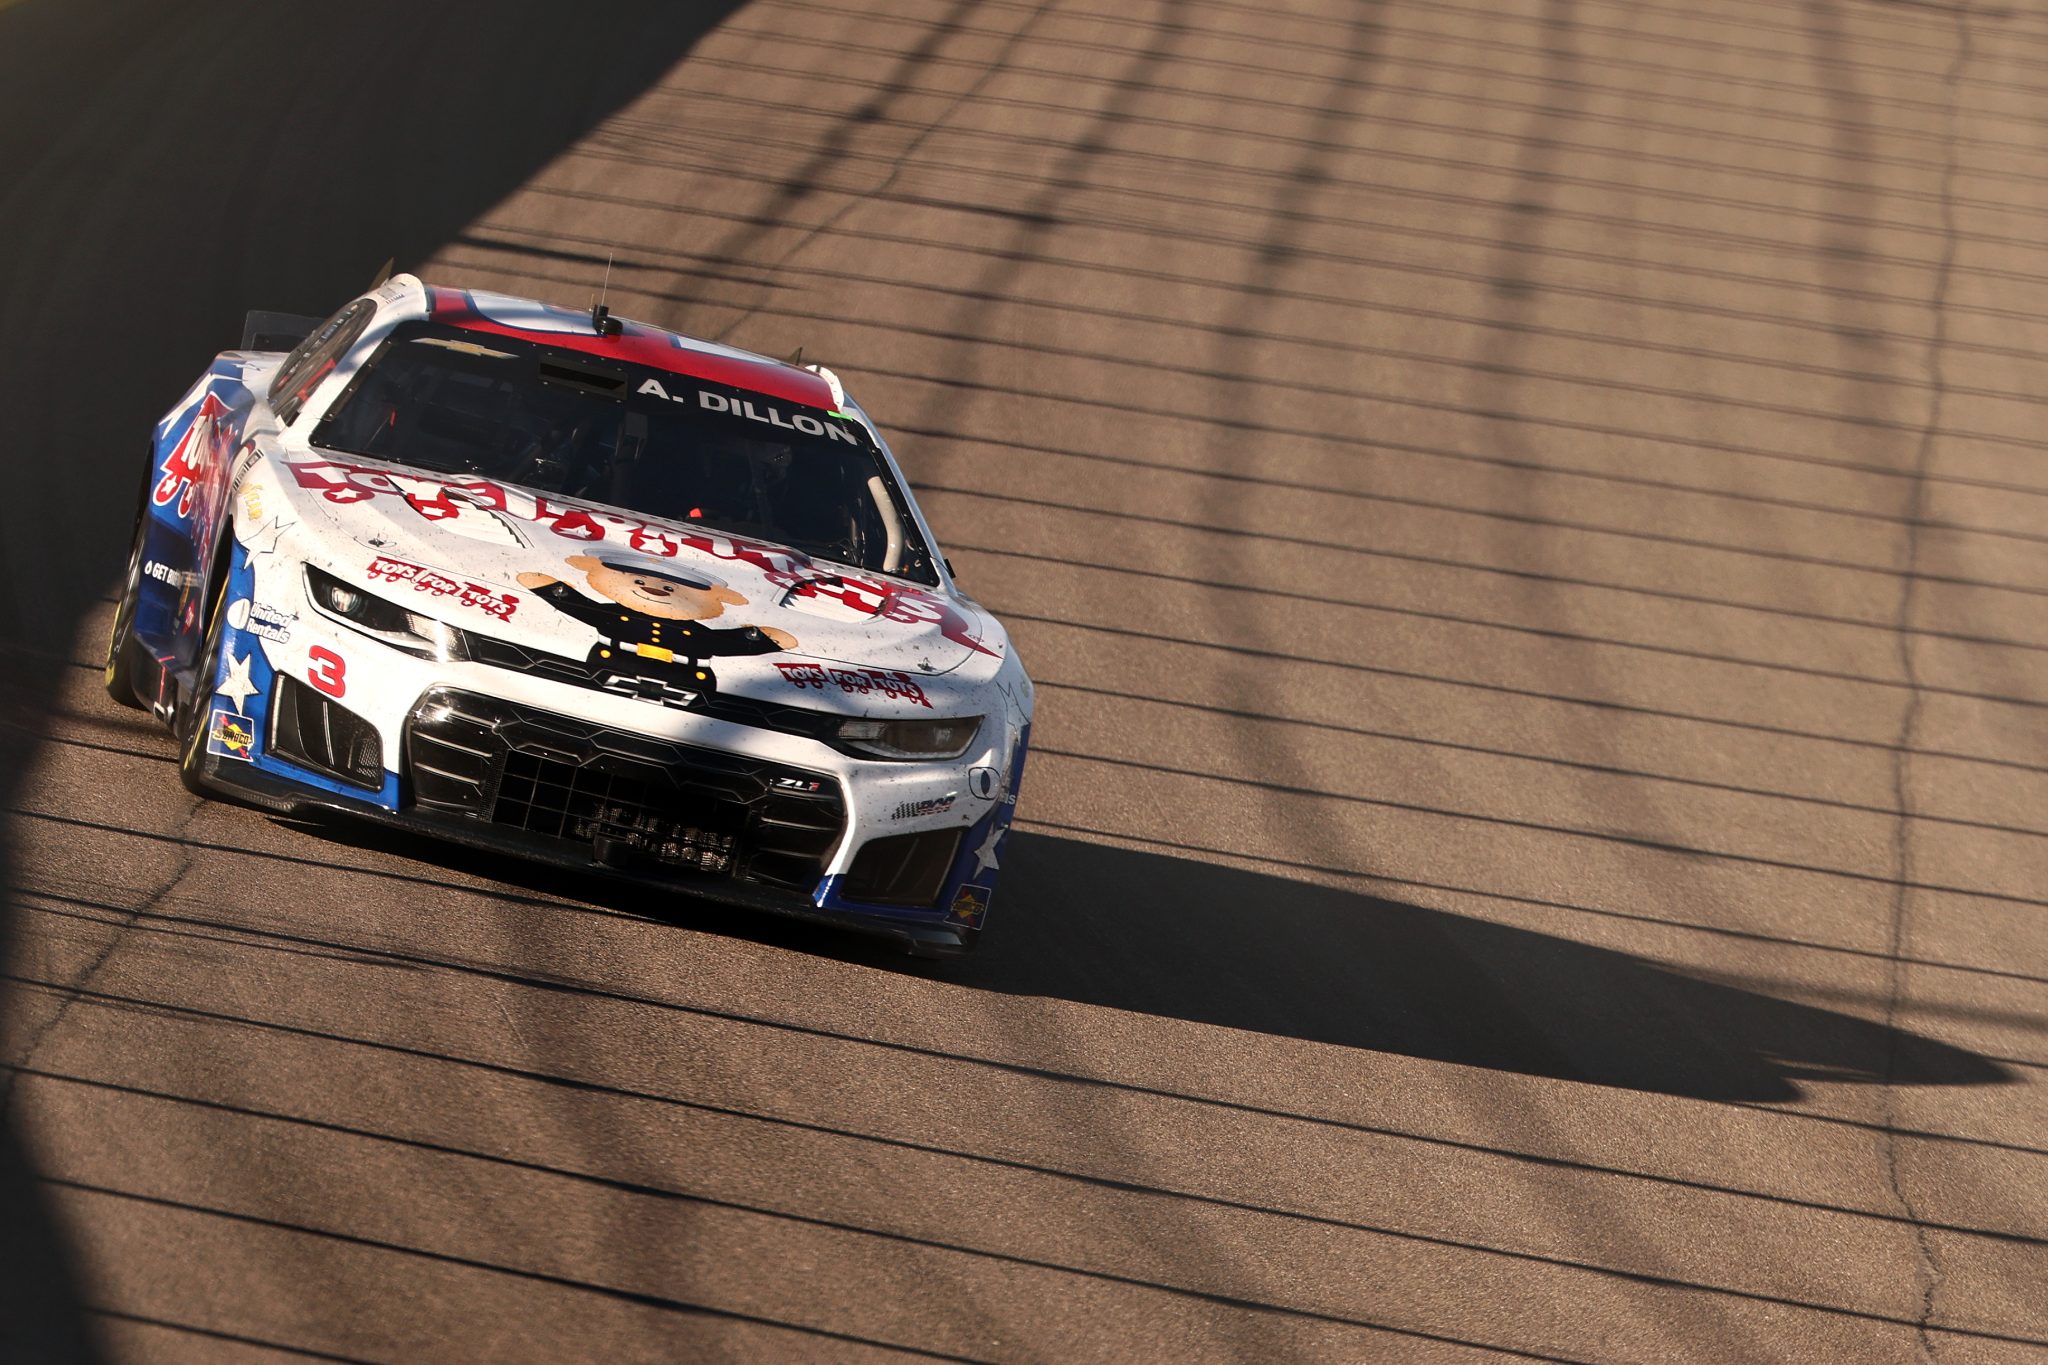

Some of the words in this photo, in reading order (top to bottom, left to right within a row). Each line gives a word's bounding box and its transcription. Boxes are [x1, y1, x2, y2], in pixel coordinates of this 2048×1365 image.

[636, 378, 684, 403] A.
[698, 390, 858, 446] DILLON
[152, 562, 169, 582] GET
[374, 559, 418, 579] TOYS
[420, 575, 457, 593] FOR
[467, 590, 512, 615] TOTS
[249, 602, 295, 627] United
[246, 618, 291, 644] Rentals
[307, 644, 346, 699] 3
[780, 665, 826, 681] TOYS
[832, 671, 869, 687] FOR
[873, 678, 921, 698] TOTS
[776, 777, 820, 793] ZL1
